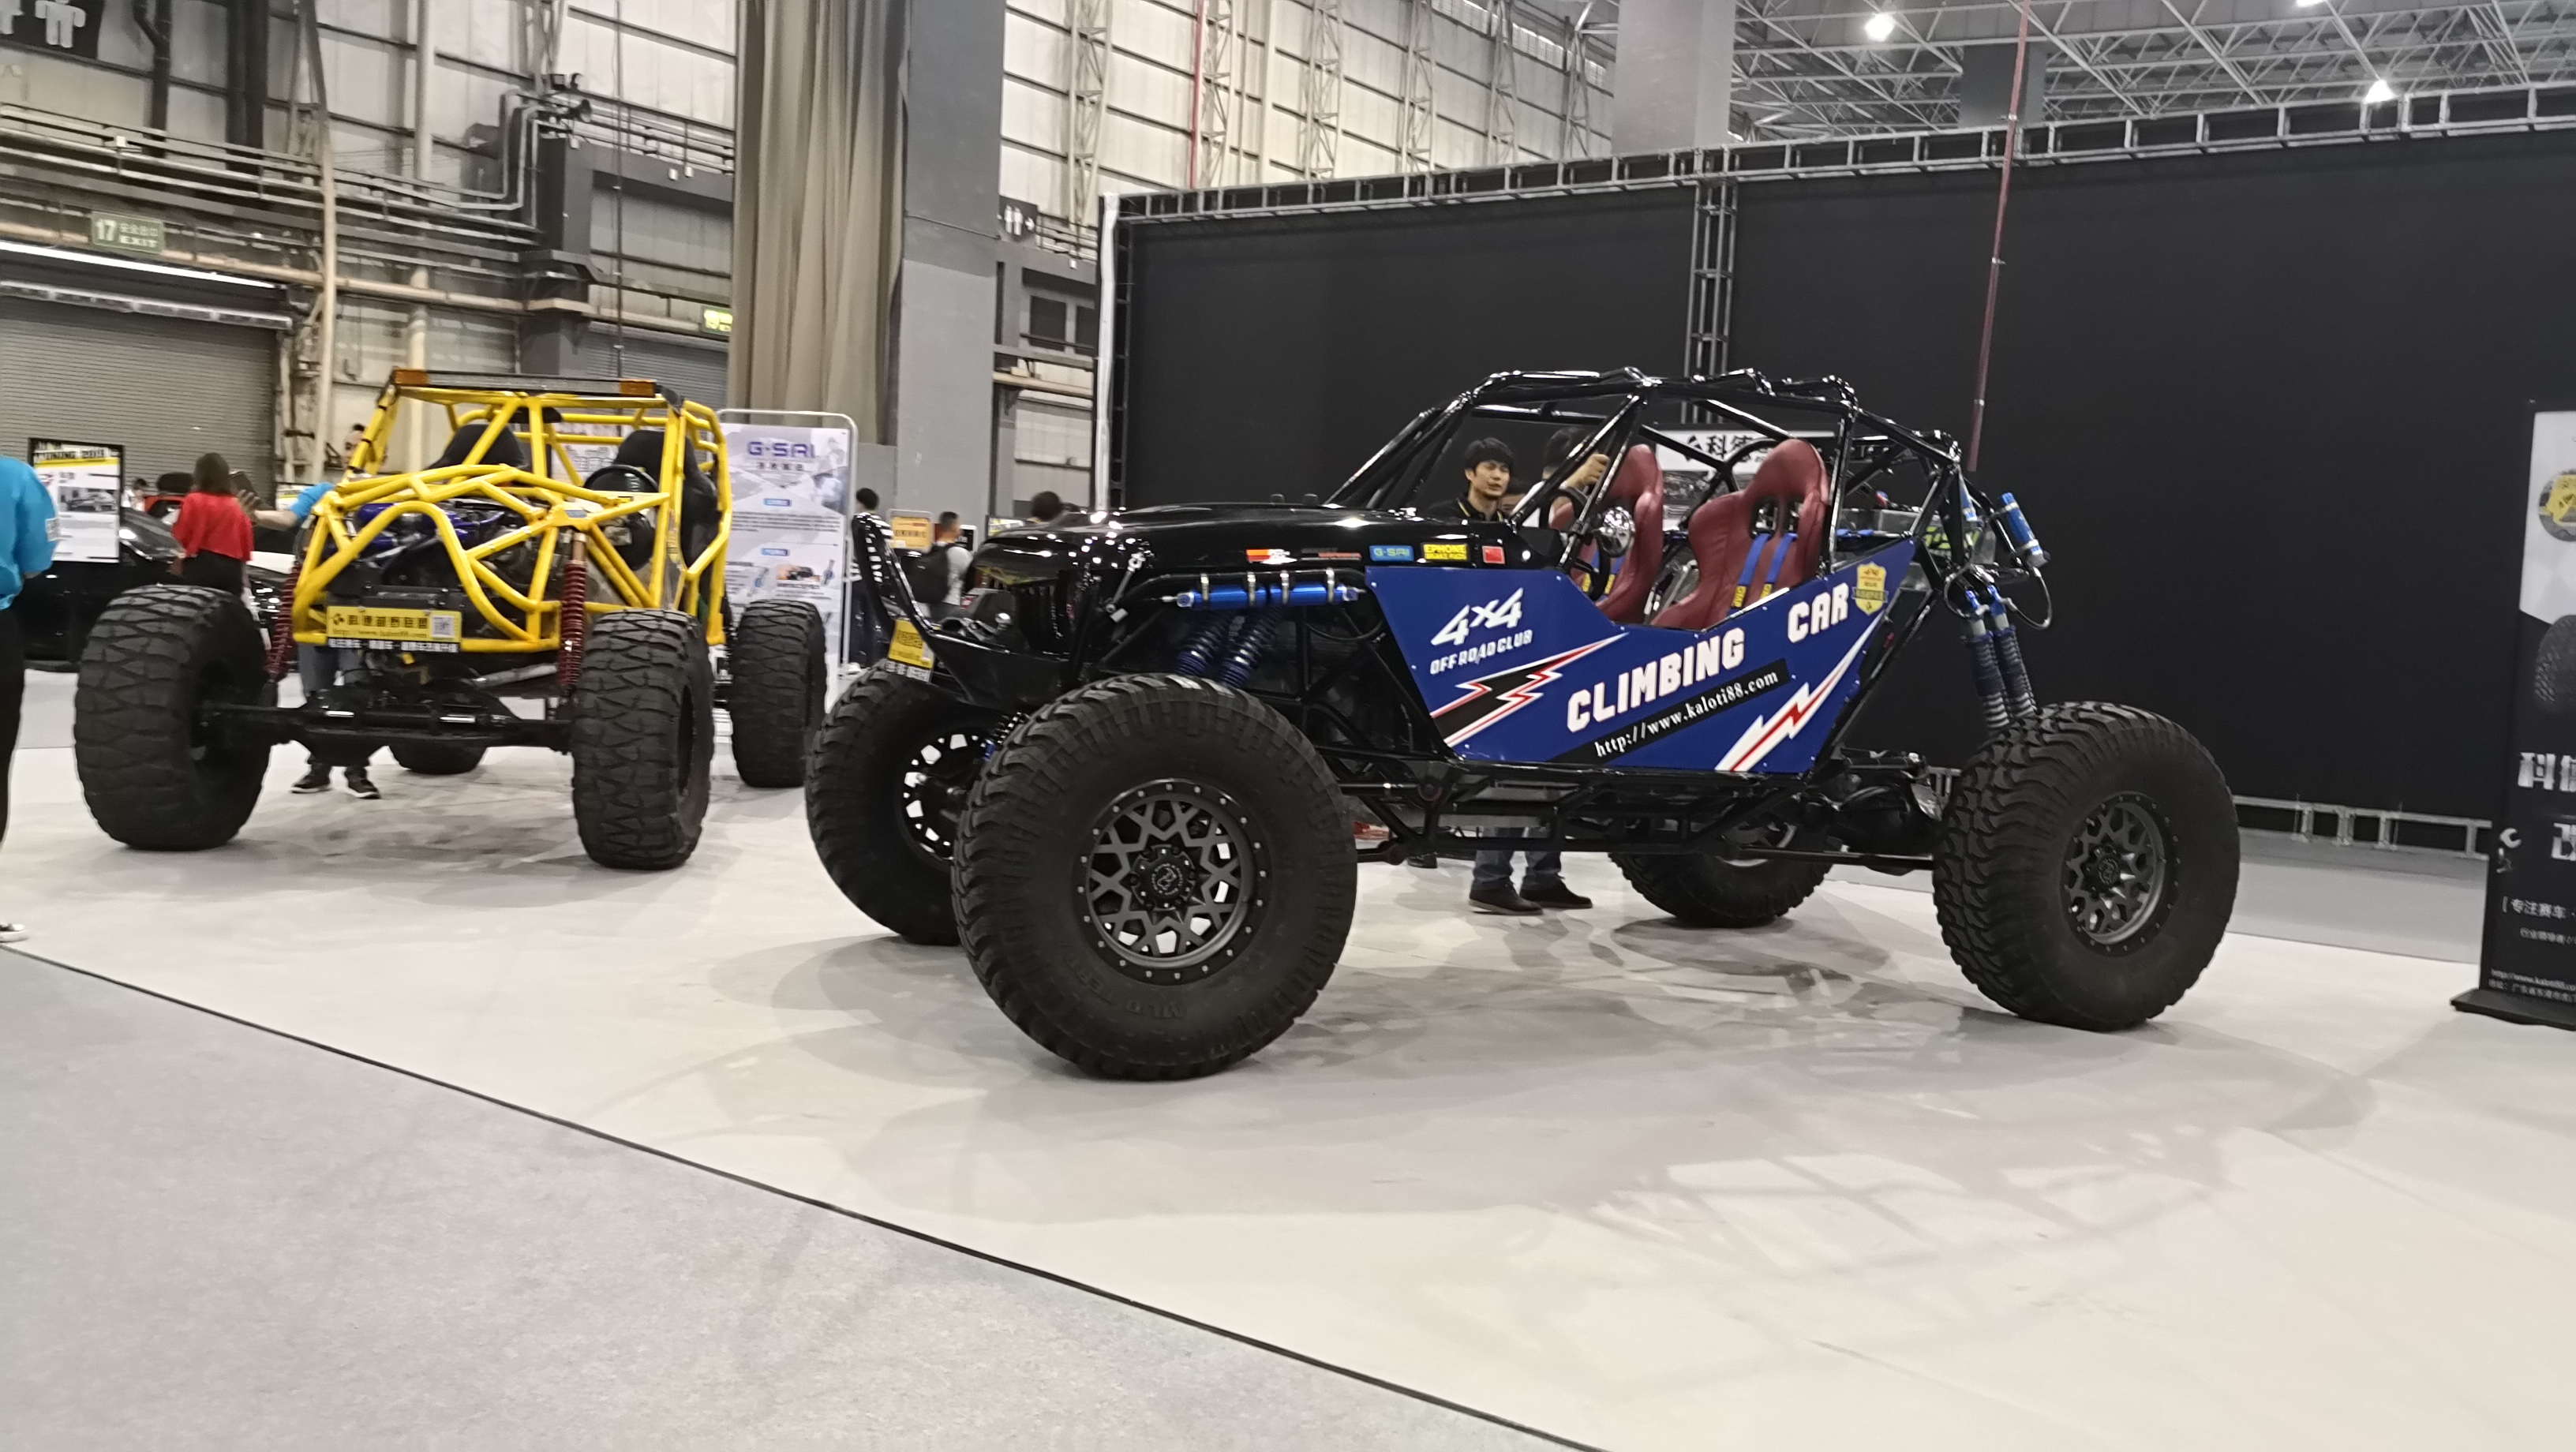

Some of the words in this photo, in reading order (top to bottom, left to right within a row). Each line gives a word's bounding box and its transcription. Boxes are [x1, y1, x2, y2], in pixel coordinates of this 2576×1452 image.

[96, 219, 117, 241] 17
[119, 234, 158, 248] EXIT
[1567, 627, 1745, 733] CLIMBING
[1787, 582, 1849, 644] CAR
[1594, 670, 1779, 758] http://www.kaloti88.com
